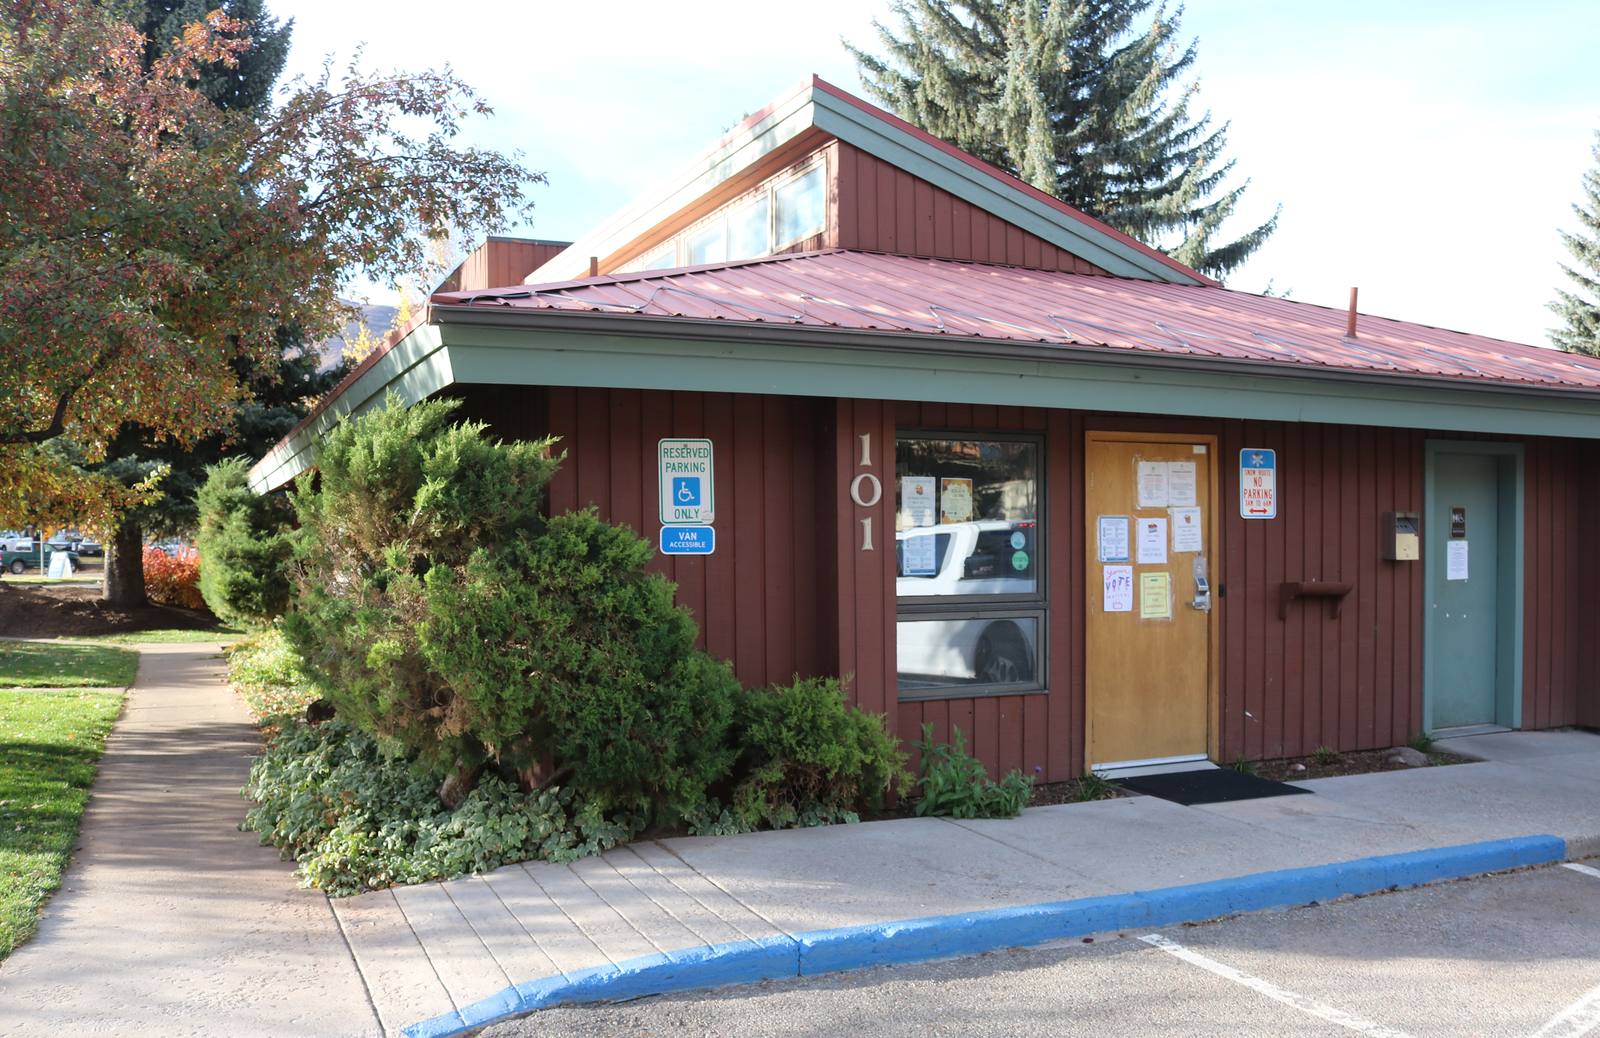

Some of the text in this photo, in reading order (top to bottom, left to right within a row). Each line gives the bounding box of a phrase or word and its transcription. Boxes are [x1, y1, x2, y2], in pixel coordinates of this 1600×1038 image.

[663, 447, 709, 459] RESERVED
[665, 462, 706, 473] PARKING
[1253, 477, 1263, 488] NO
[851, 432, 882, 551] 101
[1243, 488, 1273, 500] PARKING
[674, 508, 700, 520] ONLY
[678, 531, 697, 541] VAN
[1105, 576, 1131, 592] VOTE
